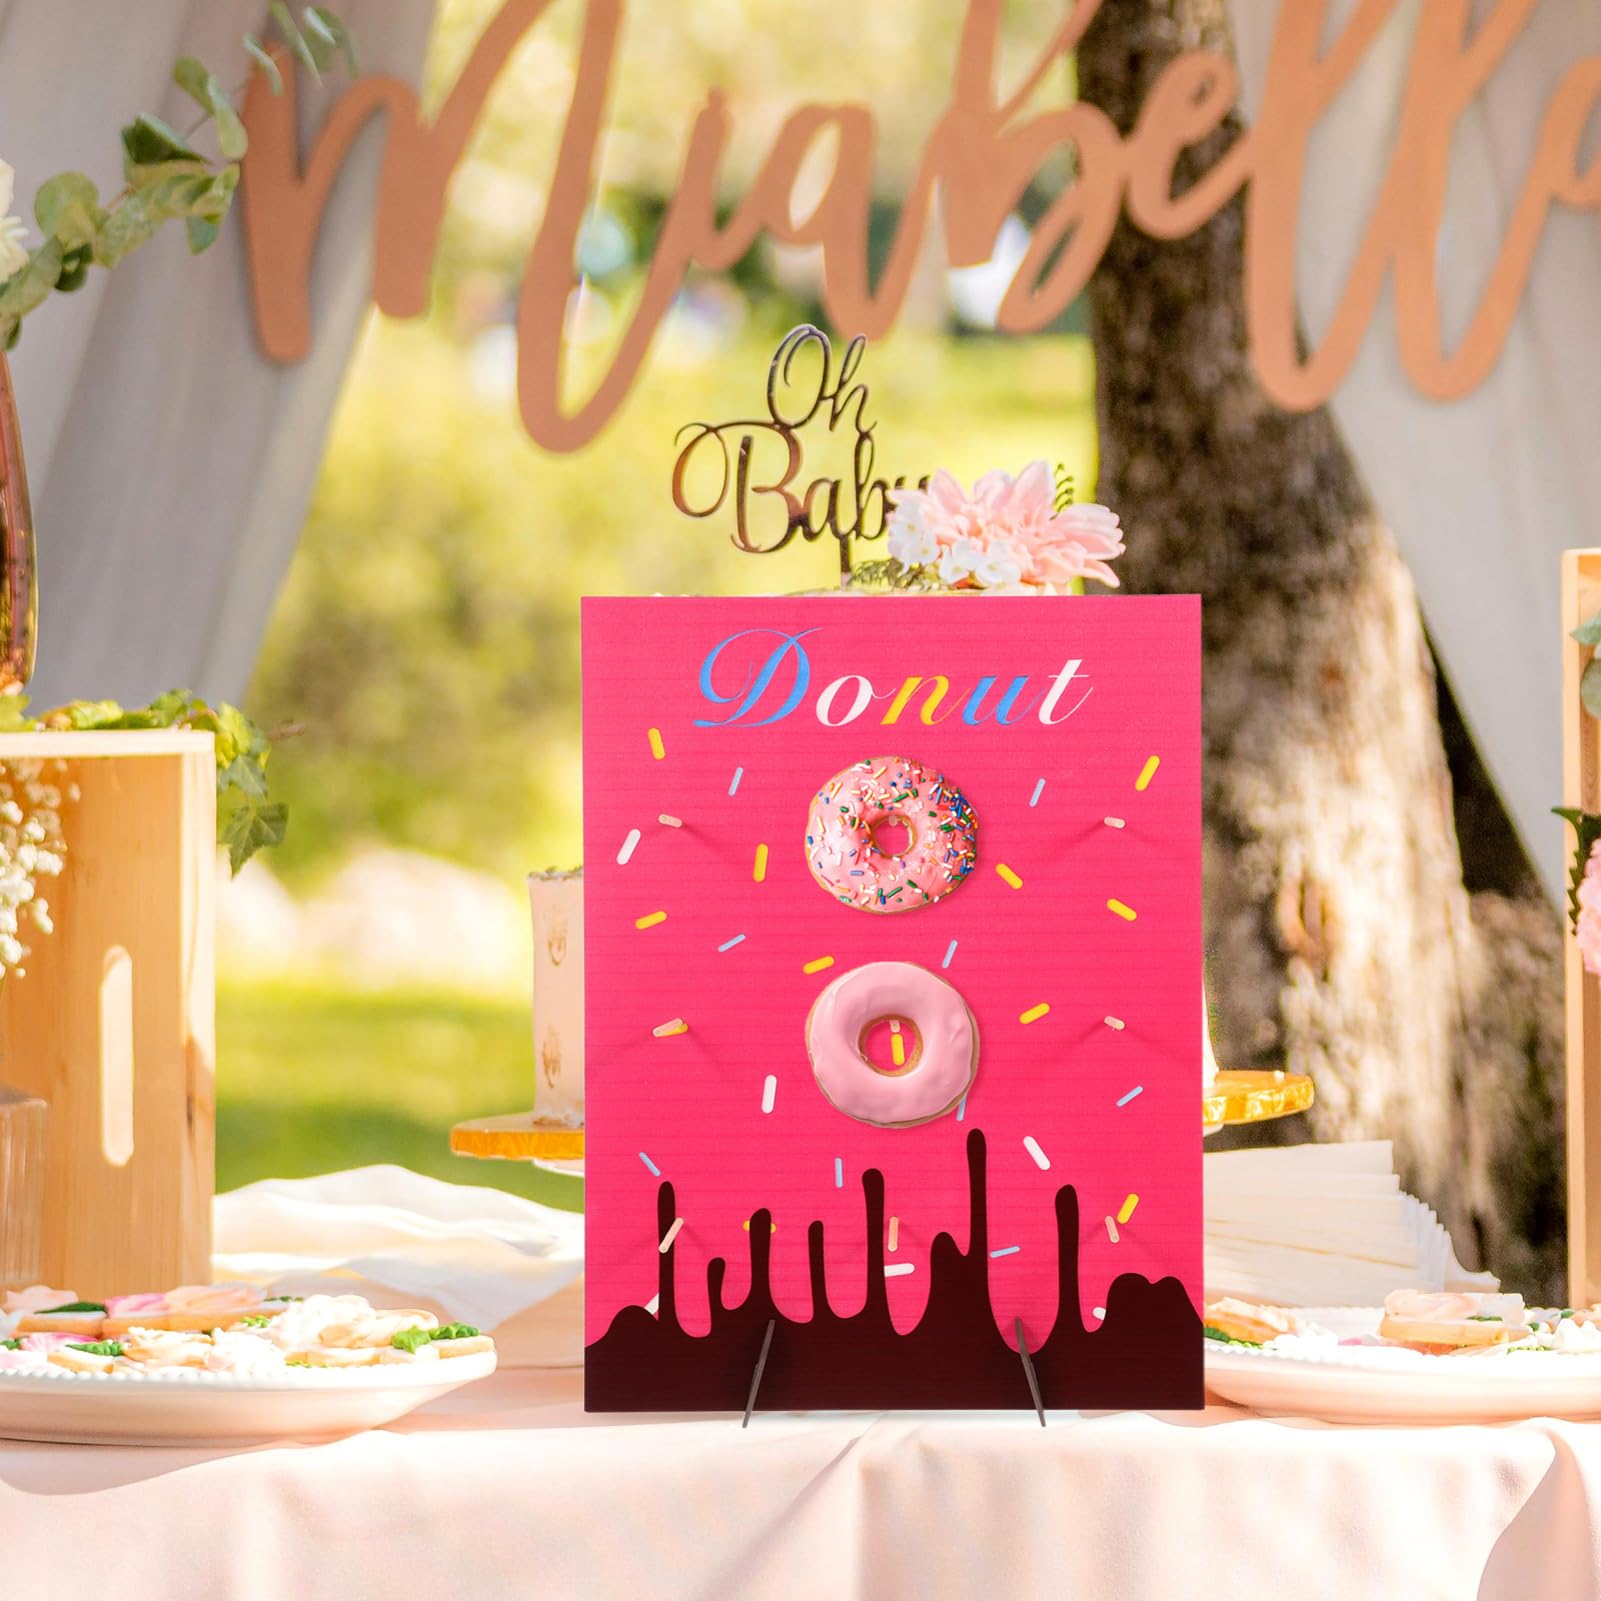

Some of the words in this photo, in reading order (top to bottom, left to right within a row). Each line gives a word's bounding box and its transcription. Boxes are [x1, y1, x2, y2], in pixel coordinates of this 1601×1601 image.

[767, 323, 877, 432] Oh
[672, 421, 930, 554] Bab
[693, 626, 1094, 728] Donut
